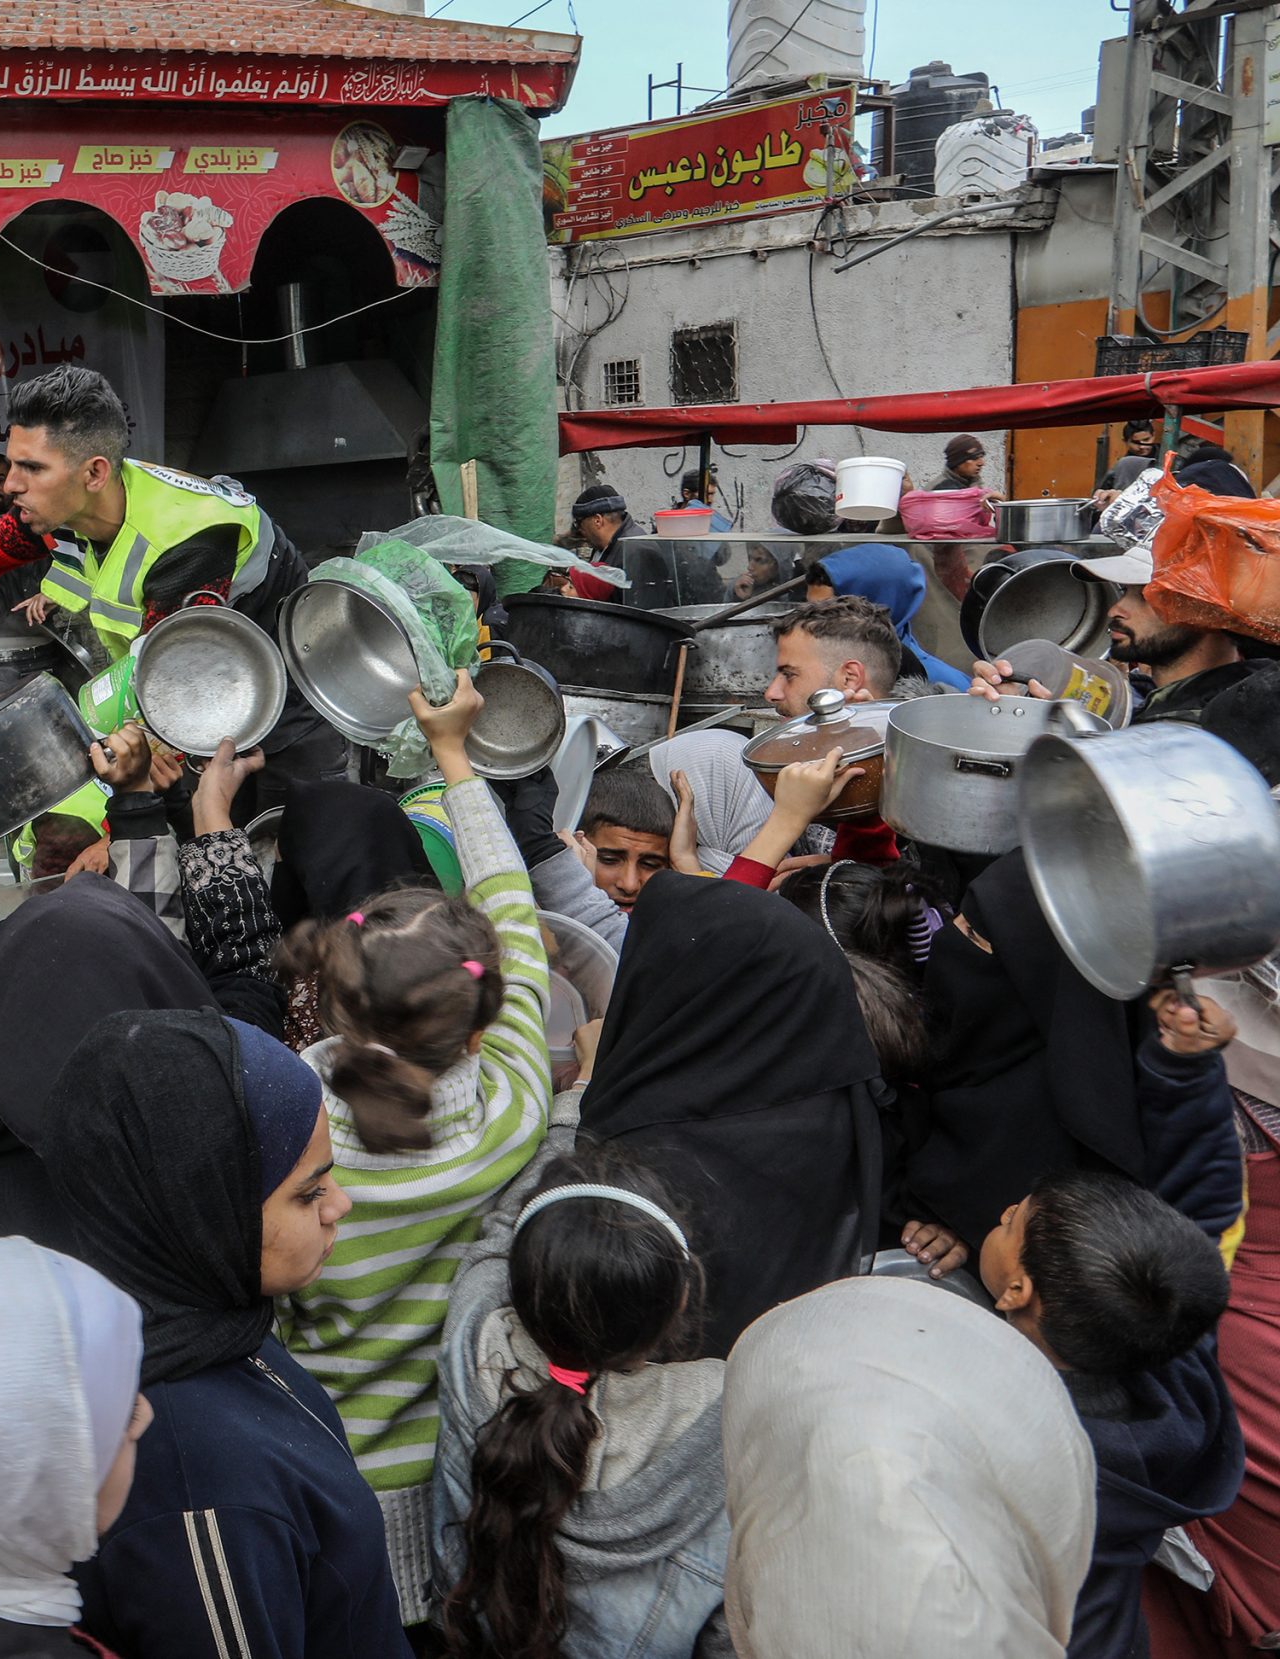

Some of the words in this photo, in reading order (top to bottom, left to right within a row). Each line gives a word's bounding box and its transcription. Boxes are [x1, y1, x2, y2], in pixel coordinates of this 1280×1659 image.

[795, 98, 847, 130] مخبز
[92, 148, 123, 171] صاج
[130, 149, 153, 171] خبز
[194, 149, 231, 173] بلدي
[236, 149, 257, 172] خبز
[711, 130, 803, 188] طابون
[20, 161, 42, 184] خبز
[628, 152, 707, 200] دعبس
[723, 199, 740, 215] خبز
[615, 210, 652, 229] السكري
